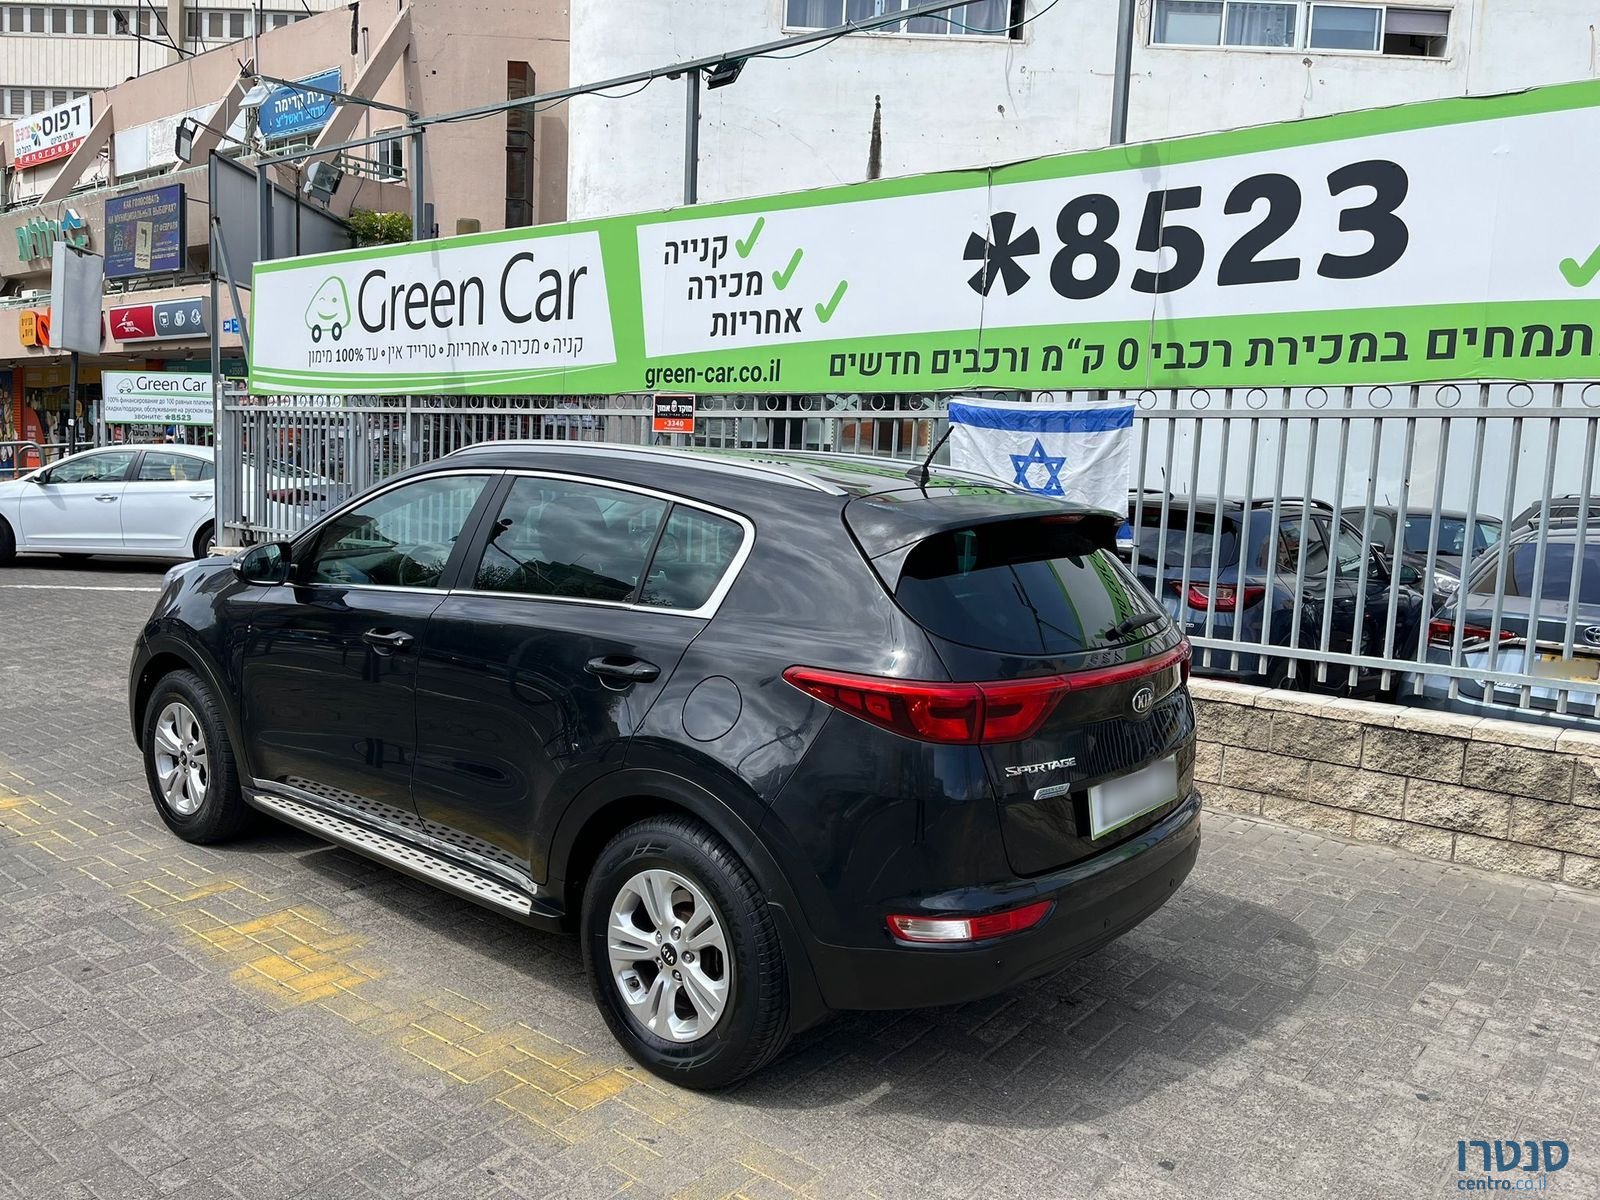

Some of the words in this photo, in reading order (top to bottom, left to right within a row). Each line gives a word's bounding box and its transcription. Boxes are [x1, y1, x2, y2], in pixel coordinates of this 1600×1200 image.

[275, 94, 304, 113] קדימה
[42, 104, 81, 137] דפוס
[664, 235, 728, 268] קנייה
[357, 268, 485, 334] Green
[500, 251, 588, 325] Car
[687, 270, 763, 300] מכירה
[710, 307, 803, 337] אחריות
[407, 344, 437, 359] טרייד
[446, 341, 489, 358] אחריות
[501, 338, 540, 356] מכירה
[552, 337, 583, 358] קניה
[1244, 331, 1409, 367] במכירת
[1426, 323, 1600, 361] תמחים
[308, 349, 333, 368] מימון
[335, 347, 364, 363] 100%
[365, 346, 379, 361] עד
[388, 345, 403, 364] אין
[829, 350, 921, 377] חדשים
[931, 346, 1029, 375] ורכבים
[1151, 339, 1233, 370] רכבי
[136, 376, 179, 391] Green
[182, 377, 207, 391] Car
[645, 358, 781, 389] green-car.co.il
[1005, 757, 1077, 777] SPORTAGE
[661, 946, 674, 965] KIA
